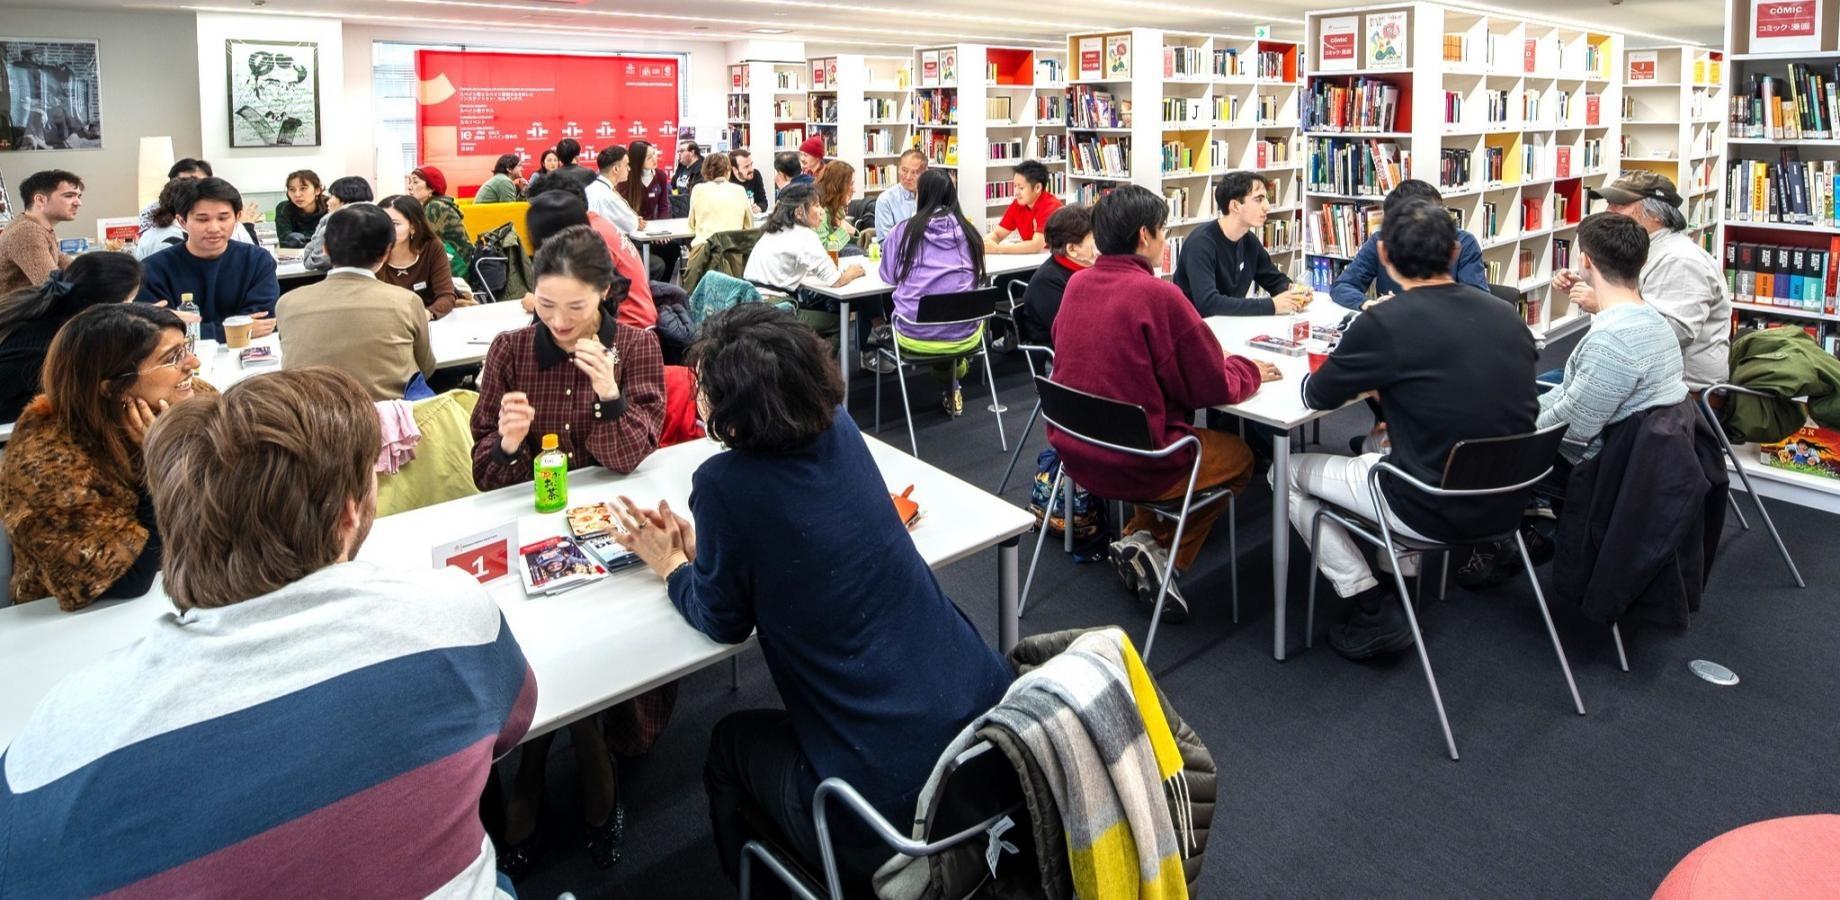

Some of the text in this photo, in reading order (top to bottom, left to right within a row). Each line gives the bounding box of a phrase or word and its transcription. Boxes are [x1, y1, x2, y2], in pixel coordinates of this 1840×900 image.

[1770, 6, 1803, 15] CÓMIC
[1759, 22, 1811, 32] コミック・漫画
[1192, 105, 1199, 119] J
[1298, 326, 1304, 337] 2
[472, 555, 490, 578] 1
